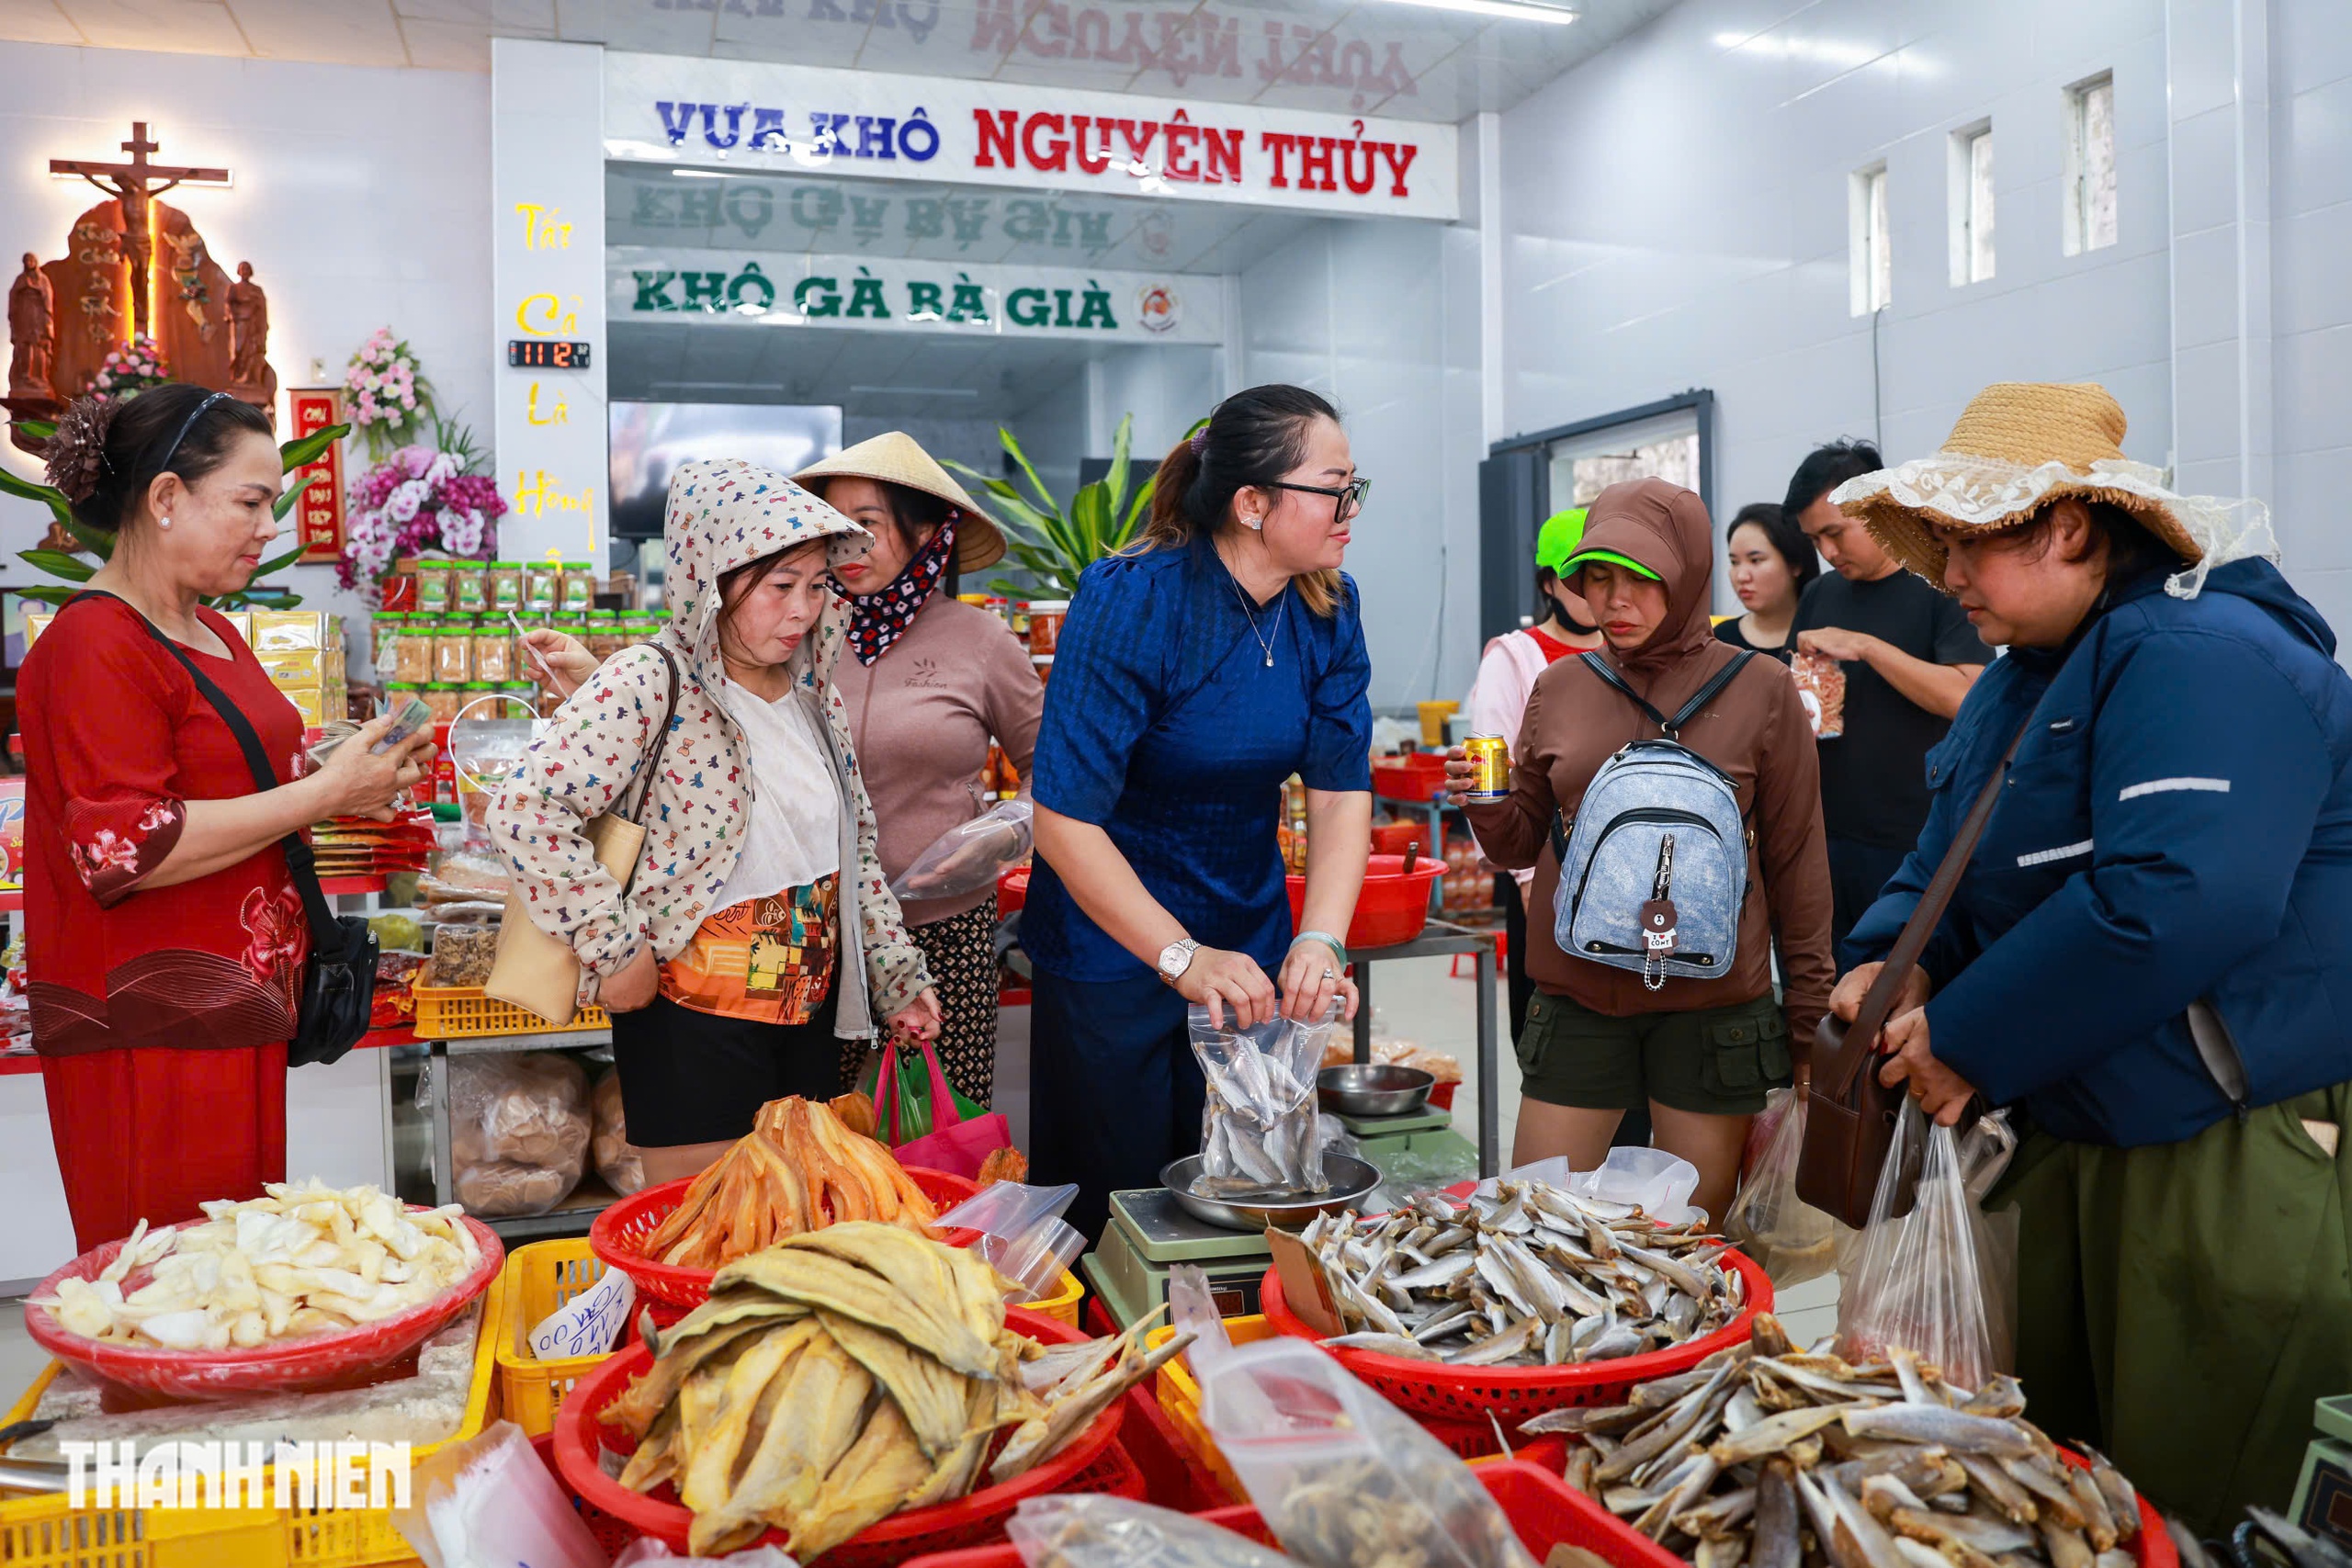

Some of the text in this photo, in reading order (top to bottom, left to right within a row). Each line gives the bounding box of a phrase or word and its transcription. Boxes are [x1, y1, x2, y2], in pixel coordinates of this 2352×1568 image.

[809, 107, 940, 162] KHÔ
[973, 108, 1244, 186] NGUYÊN
[1261, 119, 1417, 197] THỦY
[632, 262, 1118, 330] KHÔ GÀ BÀ GIÀ
[528, 381, 571, 425] Là
